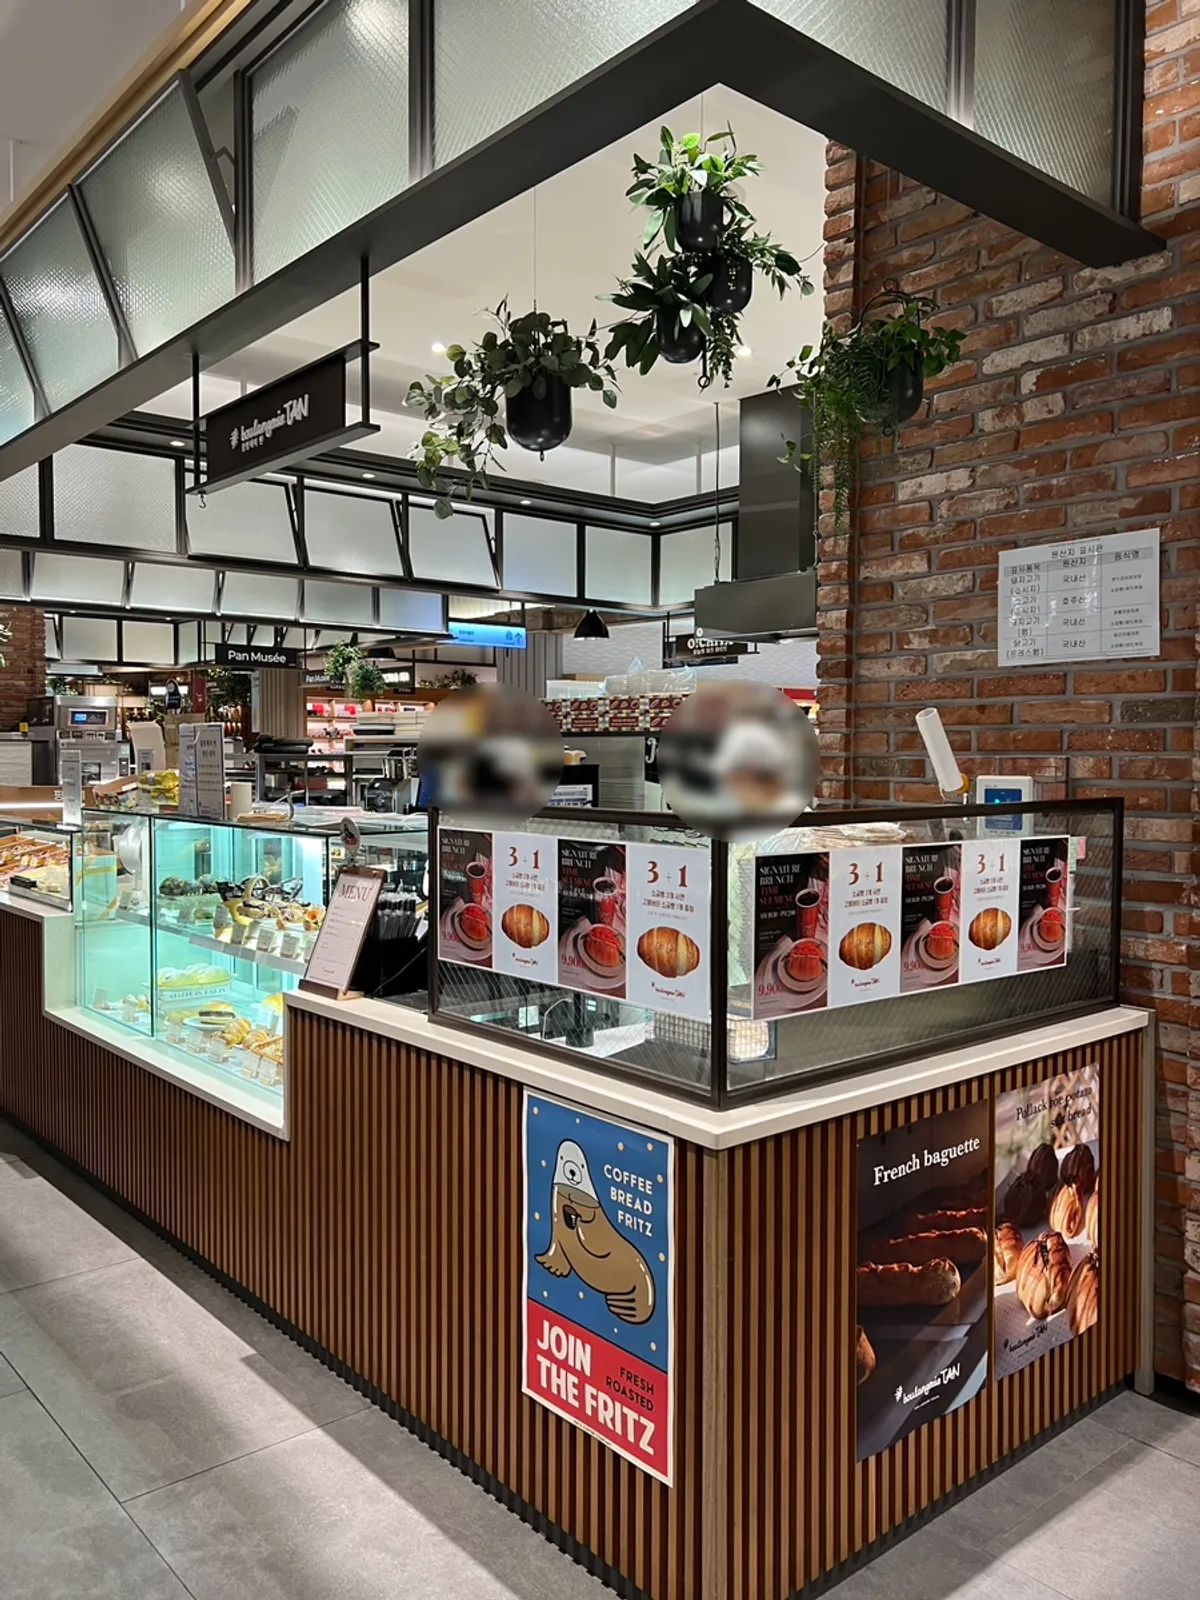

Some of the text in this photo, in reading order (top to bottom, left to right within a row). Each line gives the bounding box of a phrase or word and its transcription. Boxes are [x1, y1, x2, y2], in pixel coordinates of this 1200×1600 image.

[283, 393, 309, 426] TAN
[1063, 573, 1087, 583] 국내산
[1062, 617, 1087, 627] 국내산
[228, 650, 287, 664] Pan Musée
[1062, 639, 1087, 648] 국내산
[1016, 1098, 1048, 1121] Pollack
[873, 1137, 980, 1186] French baguette
[603, 1164, 653, 1195] COFFEE
[610, 1186, 652, 1215] BREAD
[617, 1209, 653, 1238] FRITZ
[536, 1319, 592, 1378] JOIN
[620, 1366, 655, 1396] FRESH
[940, 1362, 961, 1385] TAN
[536, 1353, 580, 1409] THE
[584, 1382, 656, 1456] FRITZ
[605, 1375, 655, 1413] ROASTED
